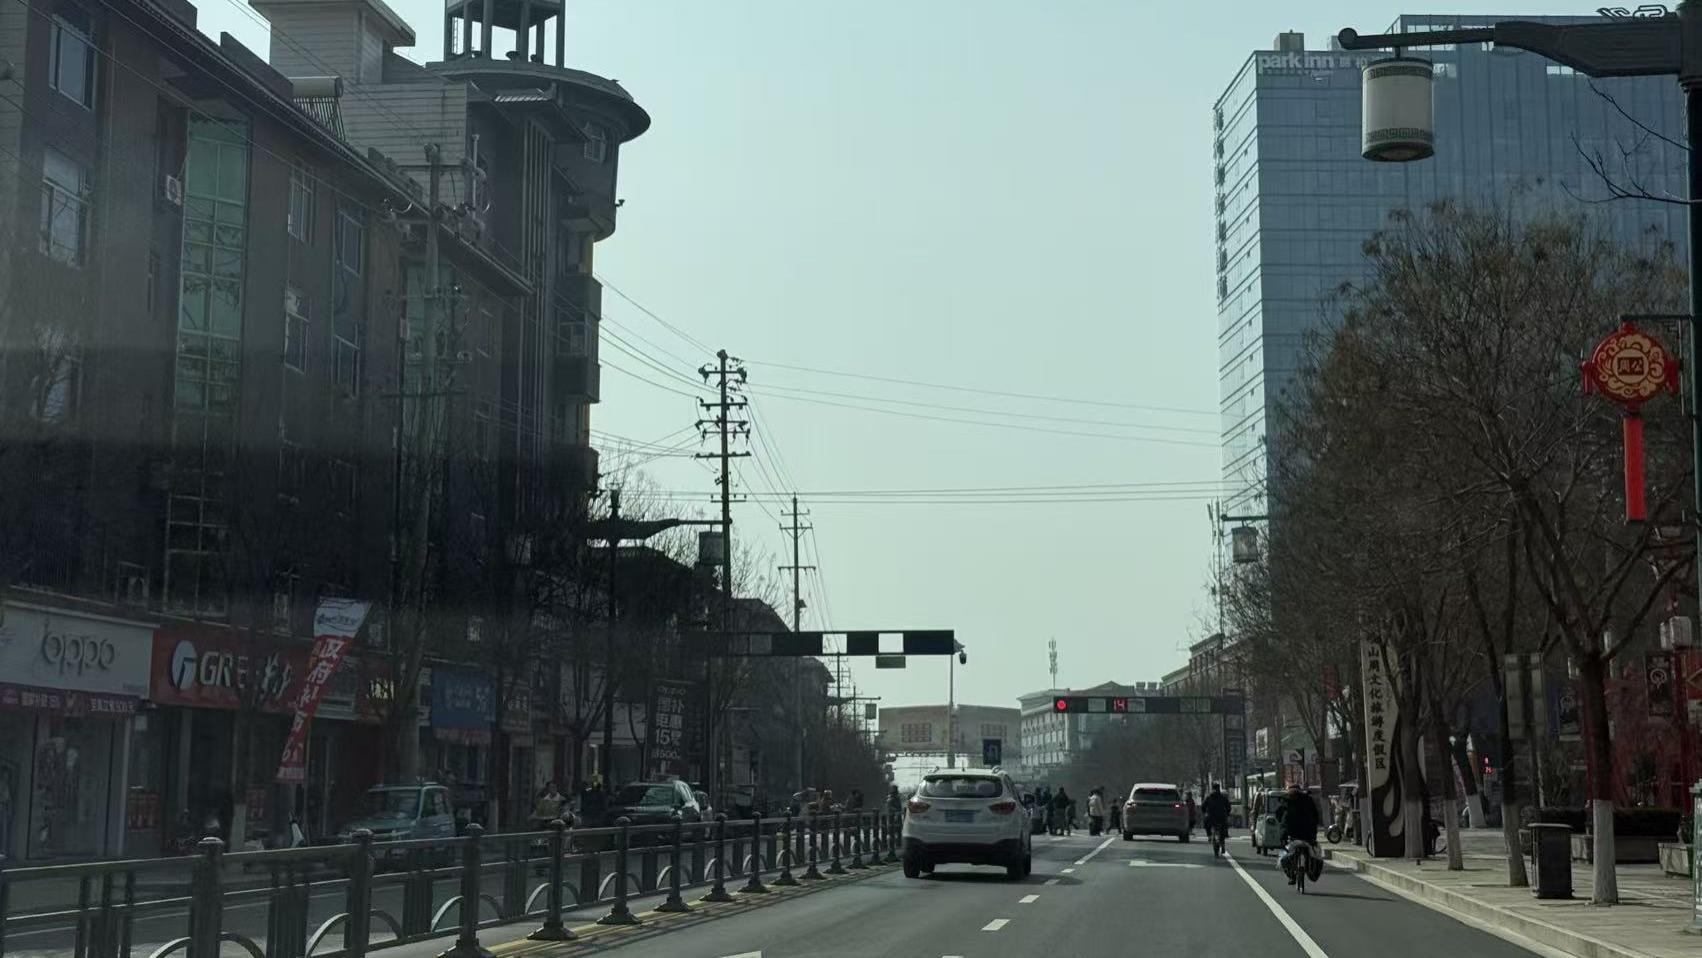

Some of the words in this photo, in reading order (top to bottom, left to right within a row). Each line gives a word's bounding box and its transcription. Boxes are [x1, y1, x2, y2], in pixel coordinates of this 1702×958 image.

[1257, 51, 1300, 74] park
[1304, 51, 1334, 68] inn
[1617, 358, 1643, 375] 周公
[42, 631, 115, 676] oppo
[1113, 698, 1127, 711] 14
[1367, 631, 1387, 770] 山周文化旅游度假区
